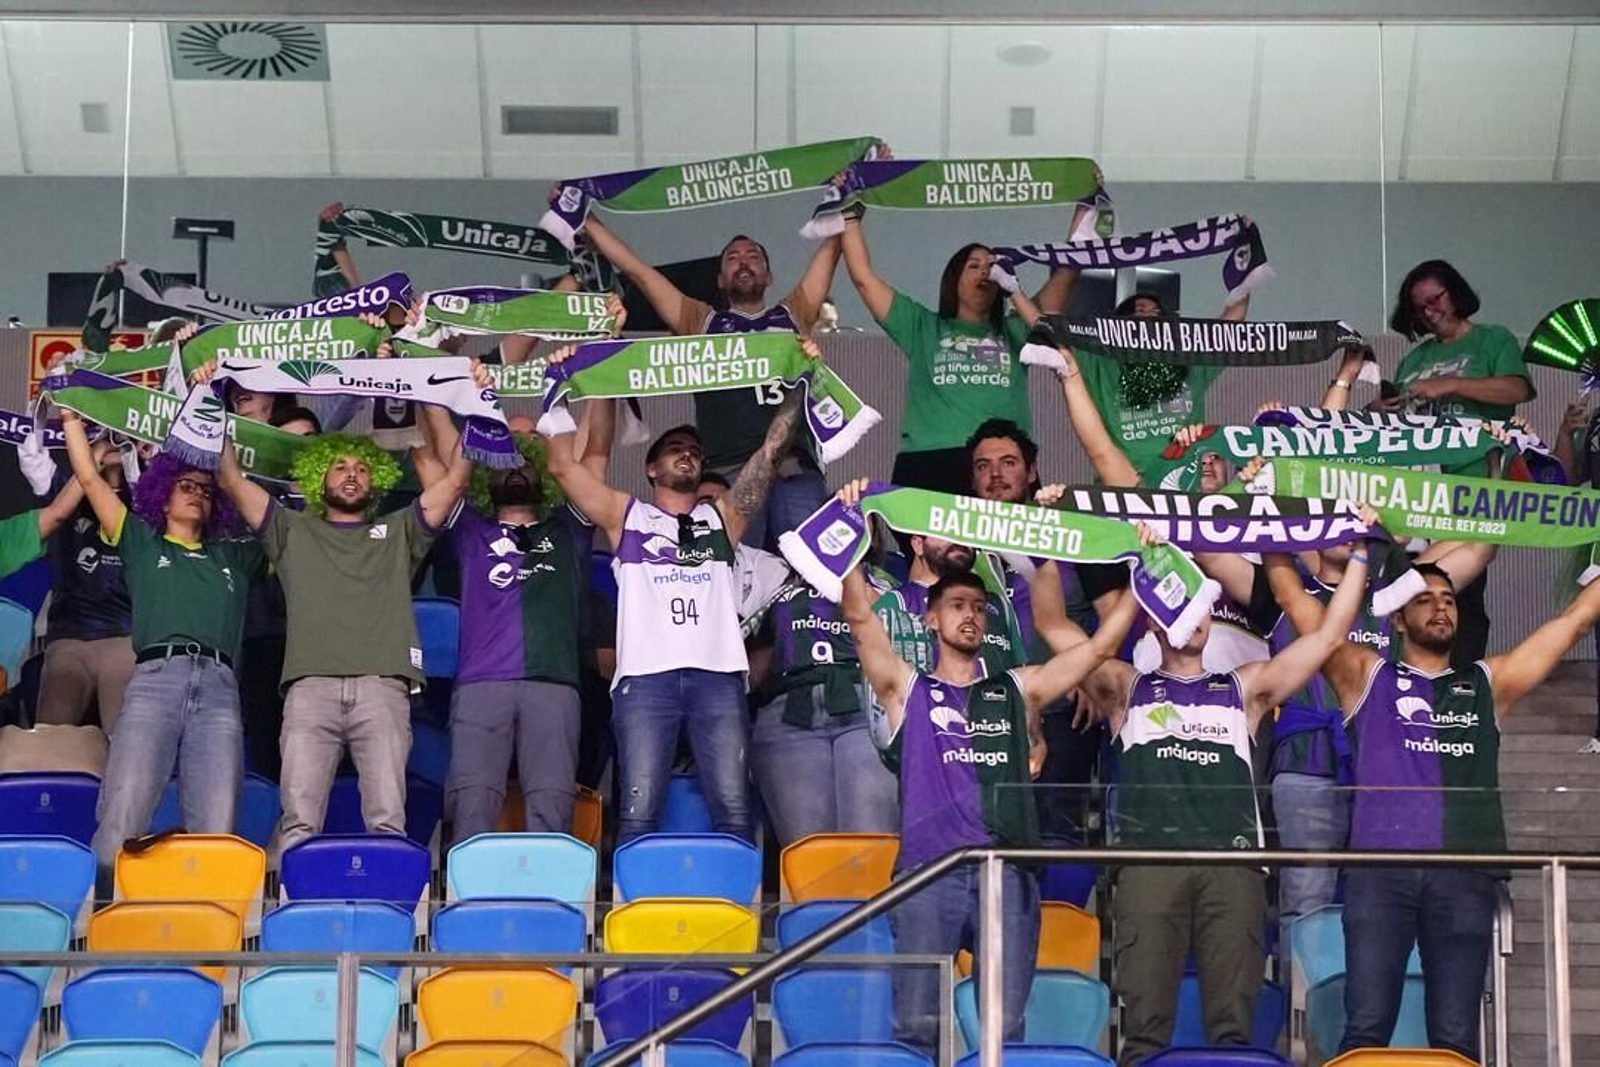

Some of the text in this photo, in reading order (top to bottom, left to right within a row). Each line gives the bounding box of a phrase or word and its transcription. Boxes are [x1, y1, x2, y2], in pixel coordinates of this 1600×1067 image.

[681, 154, 769, 184] UNICAJA
[943, 162, 1033, 184] UNICAJA
[667, 168, 793, 207] BALONCESTO
[926, 182, 1053, 205] BALONCESTO
[441, 220, 548, 254] Unicaja
[265, 285, 390, 321] oncesto
[237, 319, 333, 346] UNICAJA
[1096, 317, 1176, 352] UNICAJA
[1180, 322, 1287, 352] BALONCESTO
[649, 337, 747, 367] UNICAJA
[338, 375, 413, 393] Unicaja
[629, 357, 770, 391] BALONCESTO
[754, 381, 785, 405] 13
[1320, 466, 1450, 515] UNICAJA
[929, 506, 1083, 555] BALONCESTO
[1406, 514, 1506, 536] COPA DEL REY 2023
[654, 568, 711, 584] málaga
[671, 597, 699, 626] 94
[792, 614, 850, 635] málaga
[1349, 629, 1391, 649] nicaja
[964, 719, 1011, 734] Unicaja
[1429, 711, 1479, 727] Unicaja
[943, 747, 1008, 766] málaga
[1157, 742, 1220, 765] málaga
[1405, 737, 1475, 757] málaga
